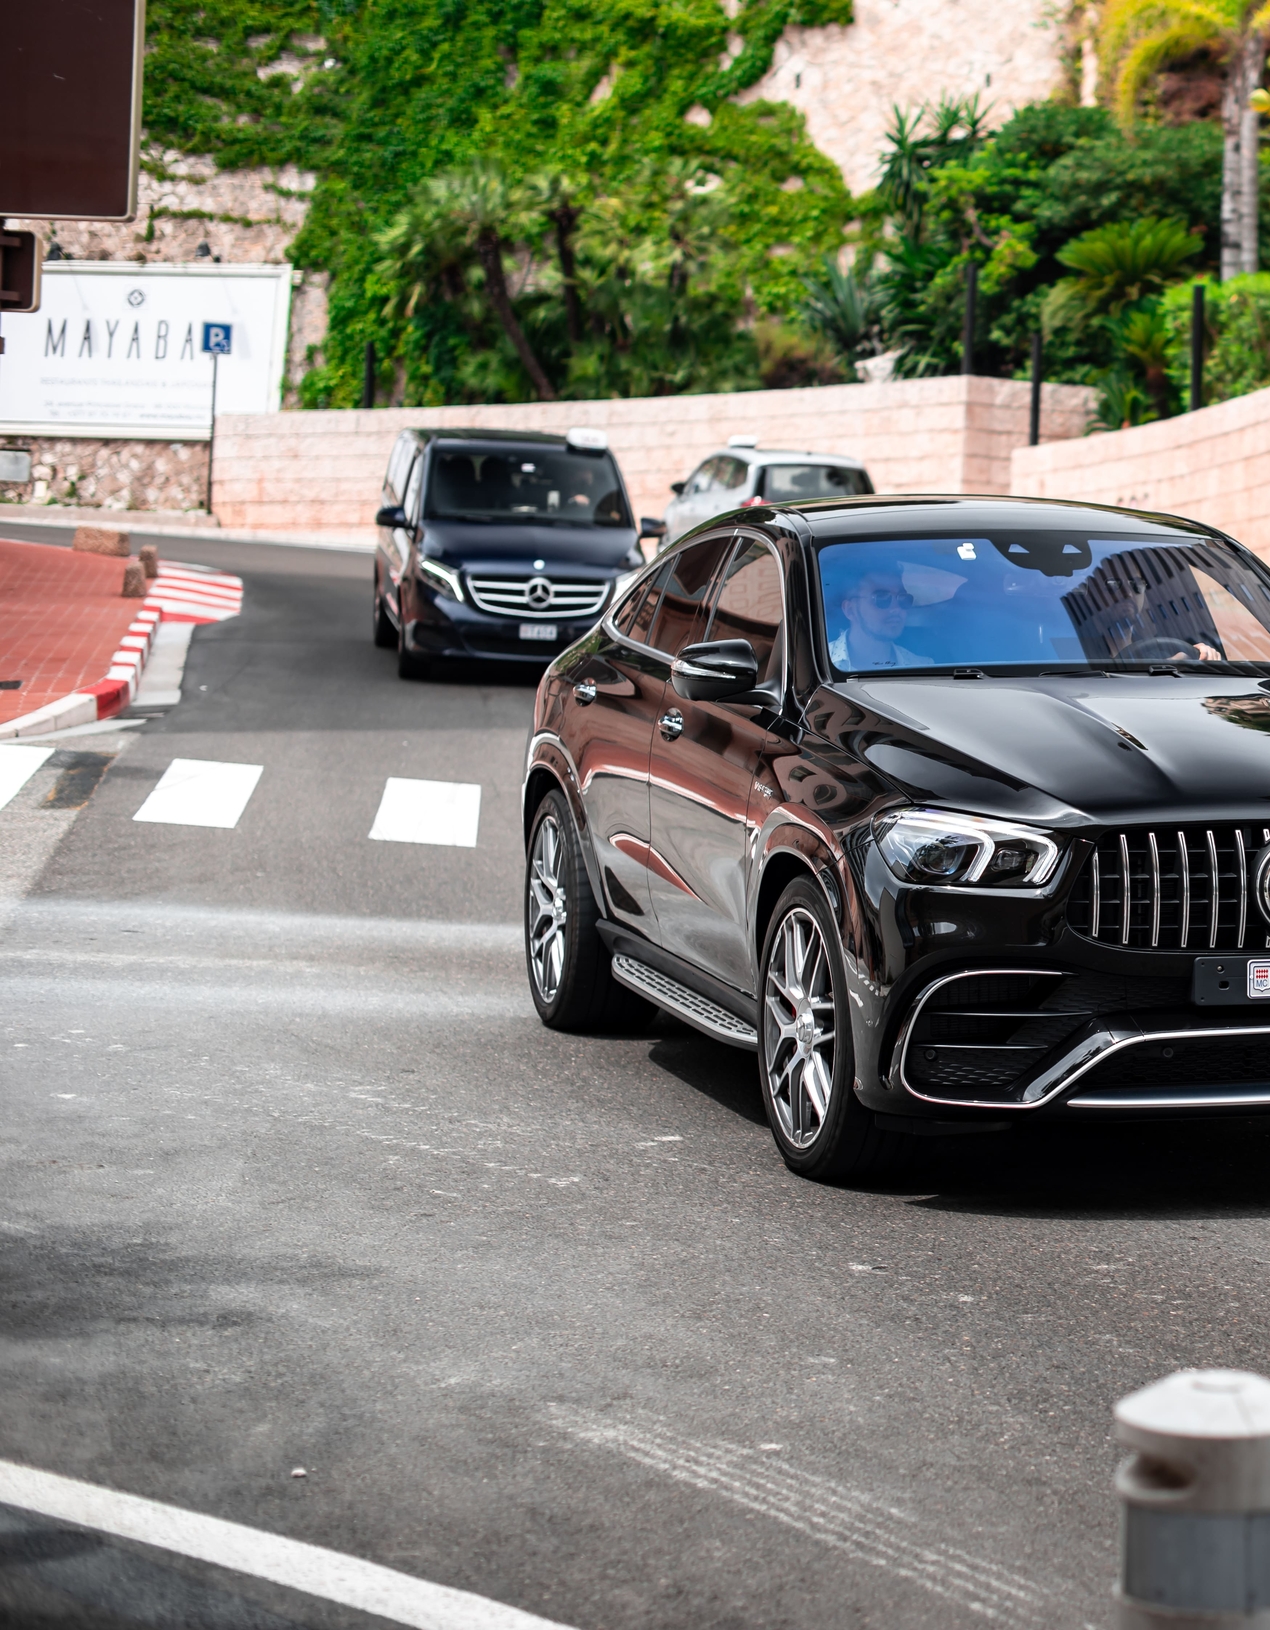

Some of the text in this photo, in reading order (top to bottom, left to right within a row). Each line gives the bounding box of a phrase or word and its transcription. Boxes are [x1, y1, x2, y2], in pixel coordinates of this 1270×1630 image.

[45, 318, 219, 361] MAYABA
[209, 327, 225, 346] P
[1256, 979, 1268, 988] MC
